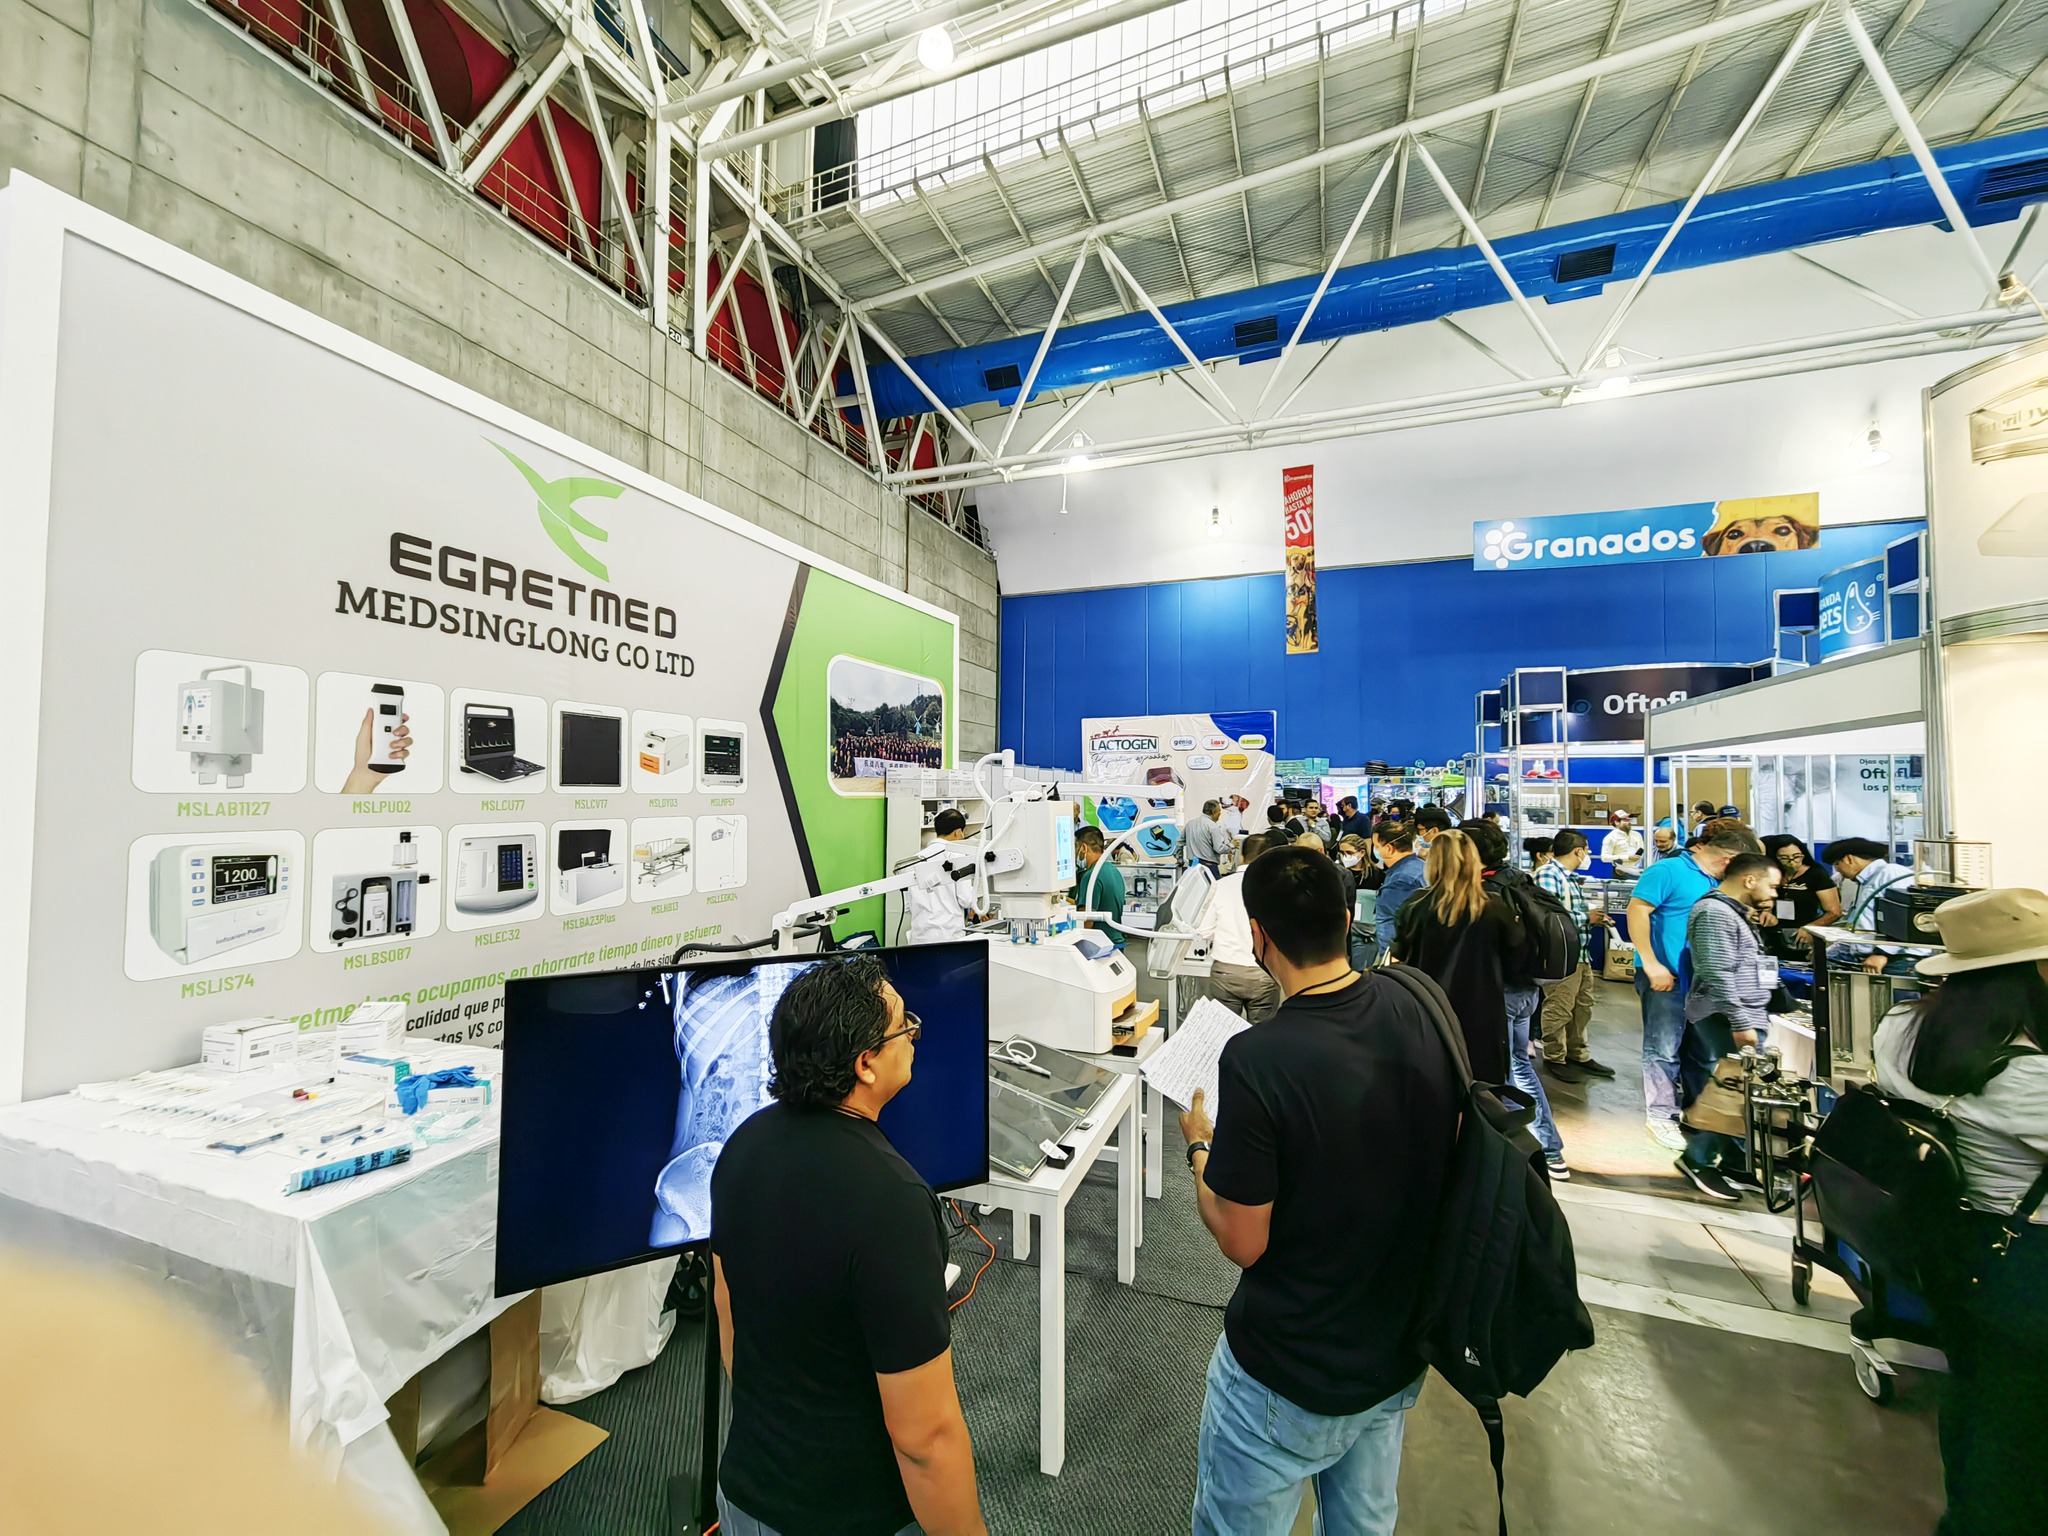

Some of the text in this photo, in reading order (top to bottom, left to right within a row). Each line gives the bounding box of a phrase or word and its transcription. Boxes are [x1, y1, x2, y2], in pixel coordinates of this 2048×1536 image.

[669, 328, 681, 343] 20
[1284, 484, 1313, 505] AHORRA
[1500, 526, 1697, 561] Granados
[390, 532, 677, 639] EGRETMED
[335, 580, 695, 678] MEDSINGLONG CO LTD
[1091, 738, 1157, 751] LACTOGEN
[1863, 783, 1879, 791] los
[177, 801, 271, 817] MSLAB1127
[352, 800, 412, 814] MSLPU02
[481, 800, 525, 811] MSLCU77
[224, 868, 258, 883] 1200
[562, 914, 616, 931] MSLBA23Plus
[474, 928, 521, 947] MSLEC32
[417, 971, 506, 1004] ocupamos
[510, 965, 529, 979] en
[532, 951, 594, 978] ahorrarte
[599, 943, 638, 961] tiempo
[641, 935, 673, 952] dinero
[675, 931, 682, 947] y
[683, 924, 722, 942] esfuerzo
[406, 1003, 461, 1031] calidad
[464, 1000, 489, 1019] que
[468, 1021, 484, 1040] VS
